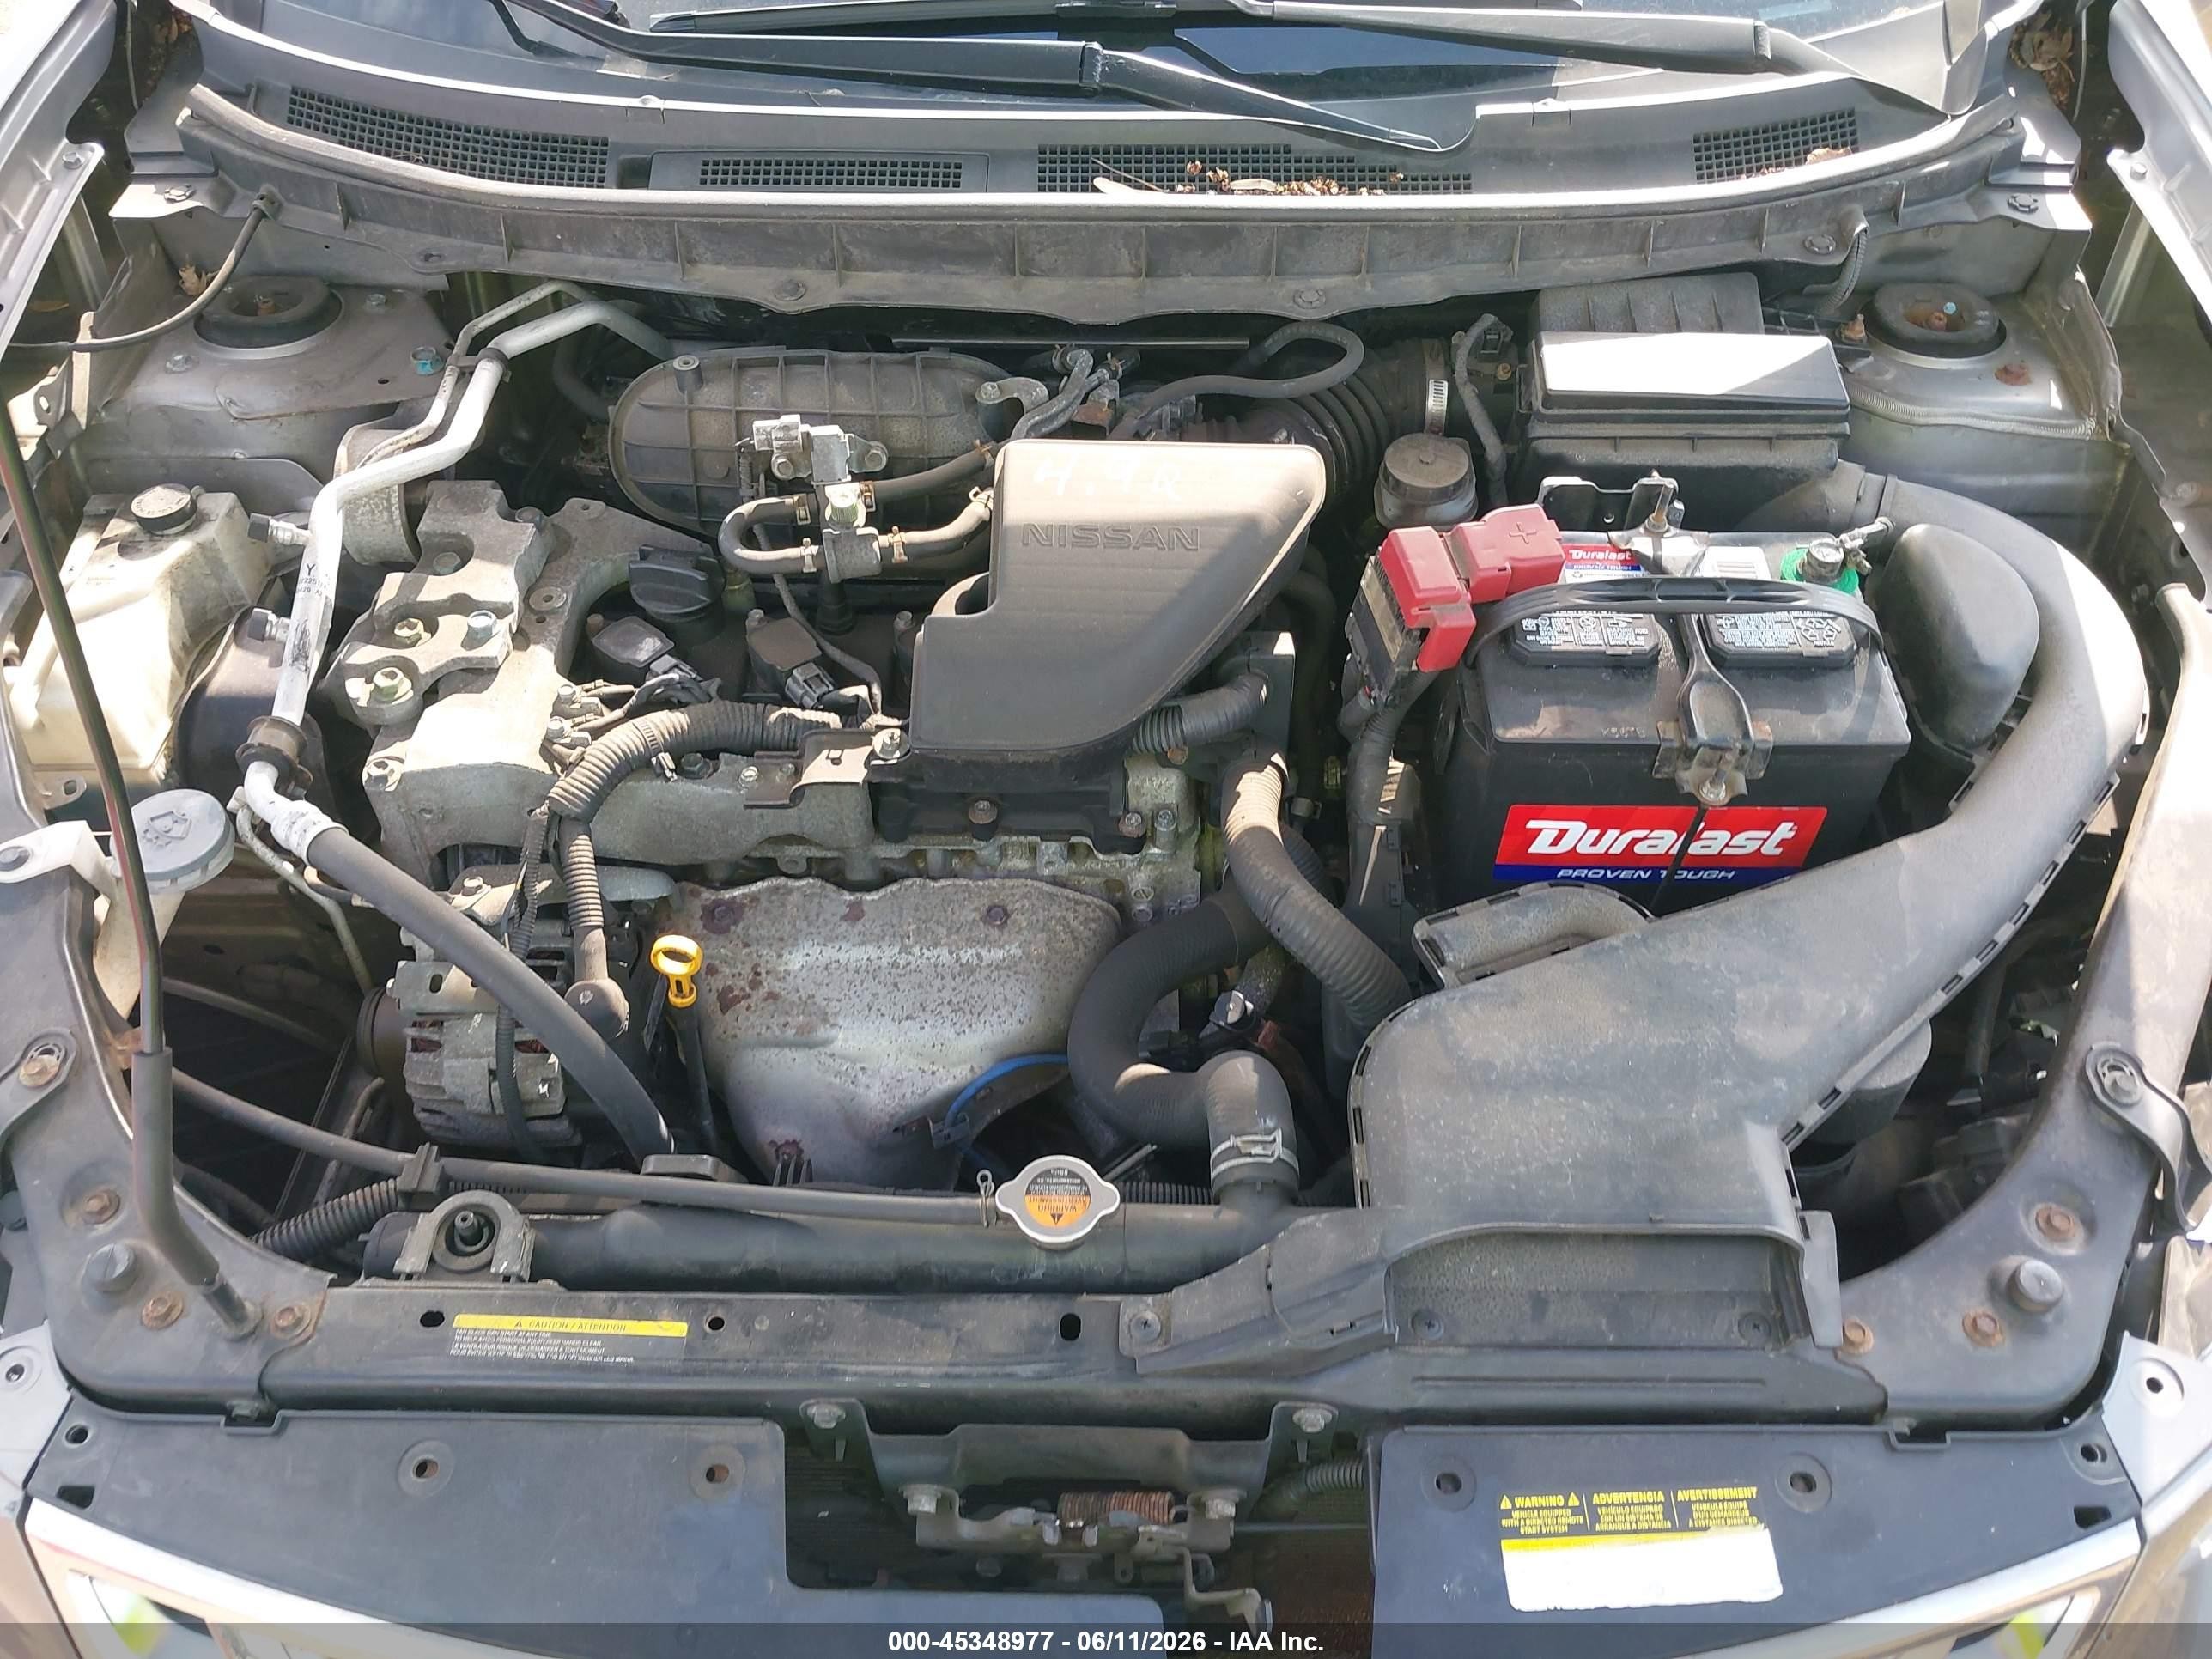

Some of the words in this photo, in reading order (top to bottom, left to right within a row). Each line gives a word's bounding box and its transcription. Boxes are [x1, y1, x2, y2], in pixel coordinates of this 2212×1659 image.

[1022, 523, 1200, 551] NISSAN
[1568, 549, 1632, 561] Duralast
[1556, 869, 1652, 879] PROVEN
[529, 1321, 568, 1330] CAUTION
[577, 1322, 626, 1331] ATTENTION
[1593, 1491, 1664, 1504] ADVERTENCIA
[1677, 1486, 1758, 1502] AVERTISSEMENT
[1515, 1494, 1565, 1508] WARNING
